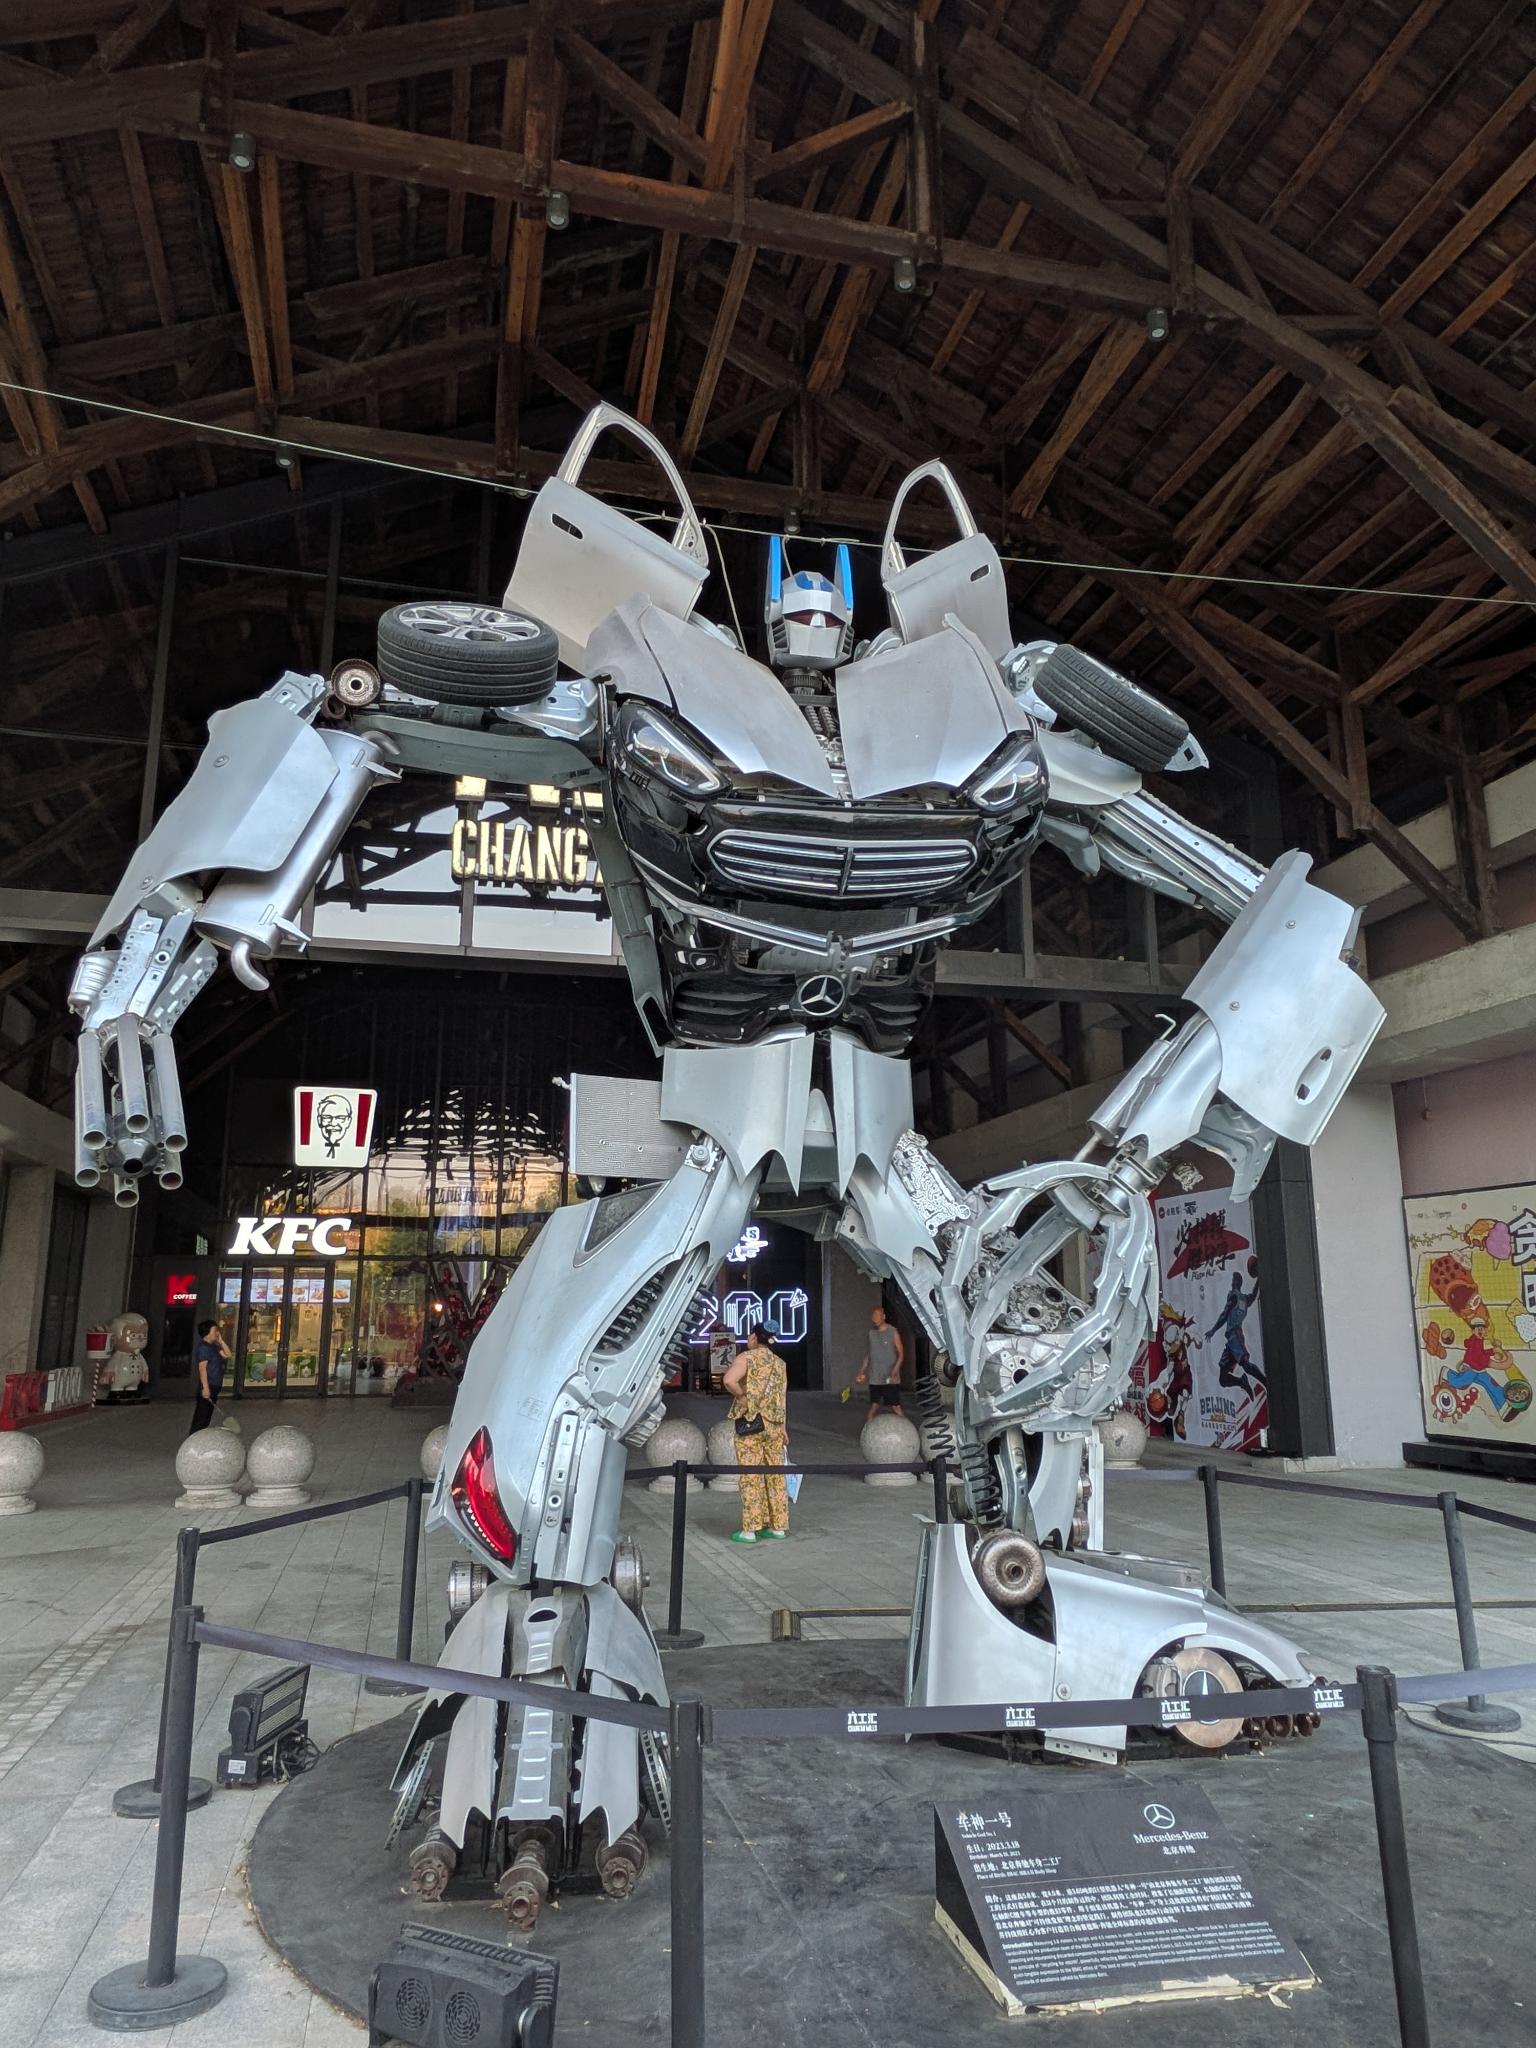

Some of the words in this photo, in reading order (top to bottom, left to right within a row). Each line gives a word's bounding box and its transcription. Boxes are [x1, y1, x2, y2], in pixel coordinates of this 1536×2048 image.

[452, 819, 604, 886] CHANG
[228, 1218, 352, 1256] KFC
[1200, 1396, 1236, 1418] BEIJING
[956, 1812, 1012, 1831] 车神一号
[1133, 1831, 1209, 1844] Mercedes-Benz
